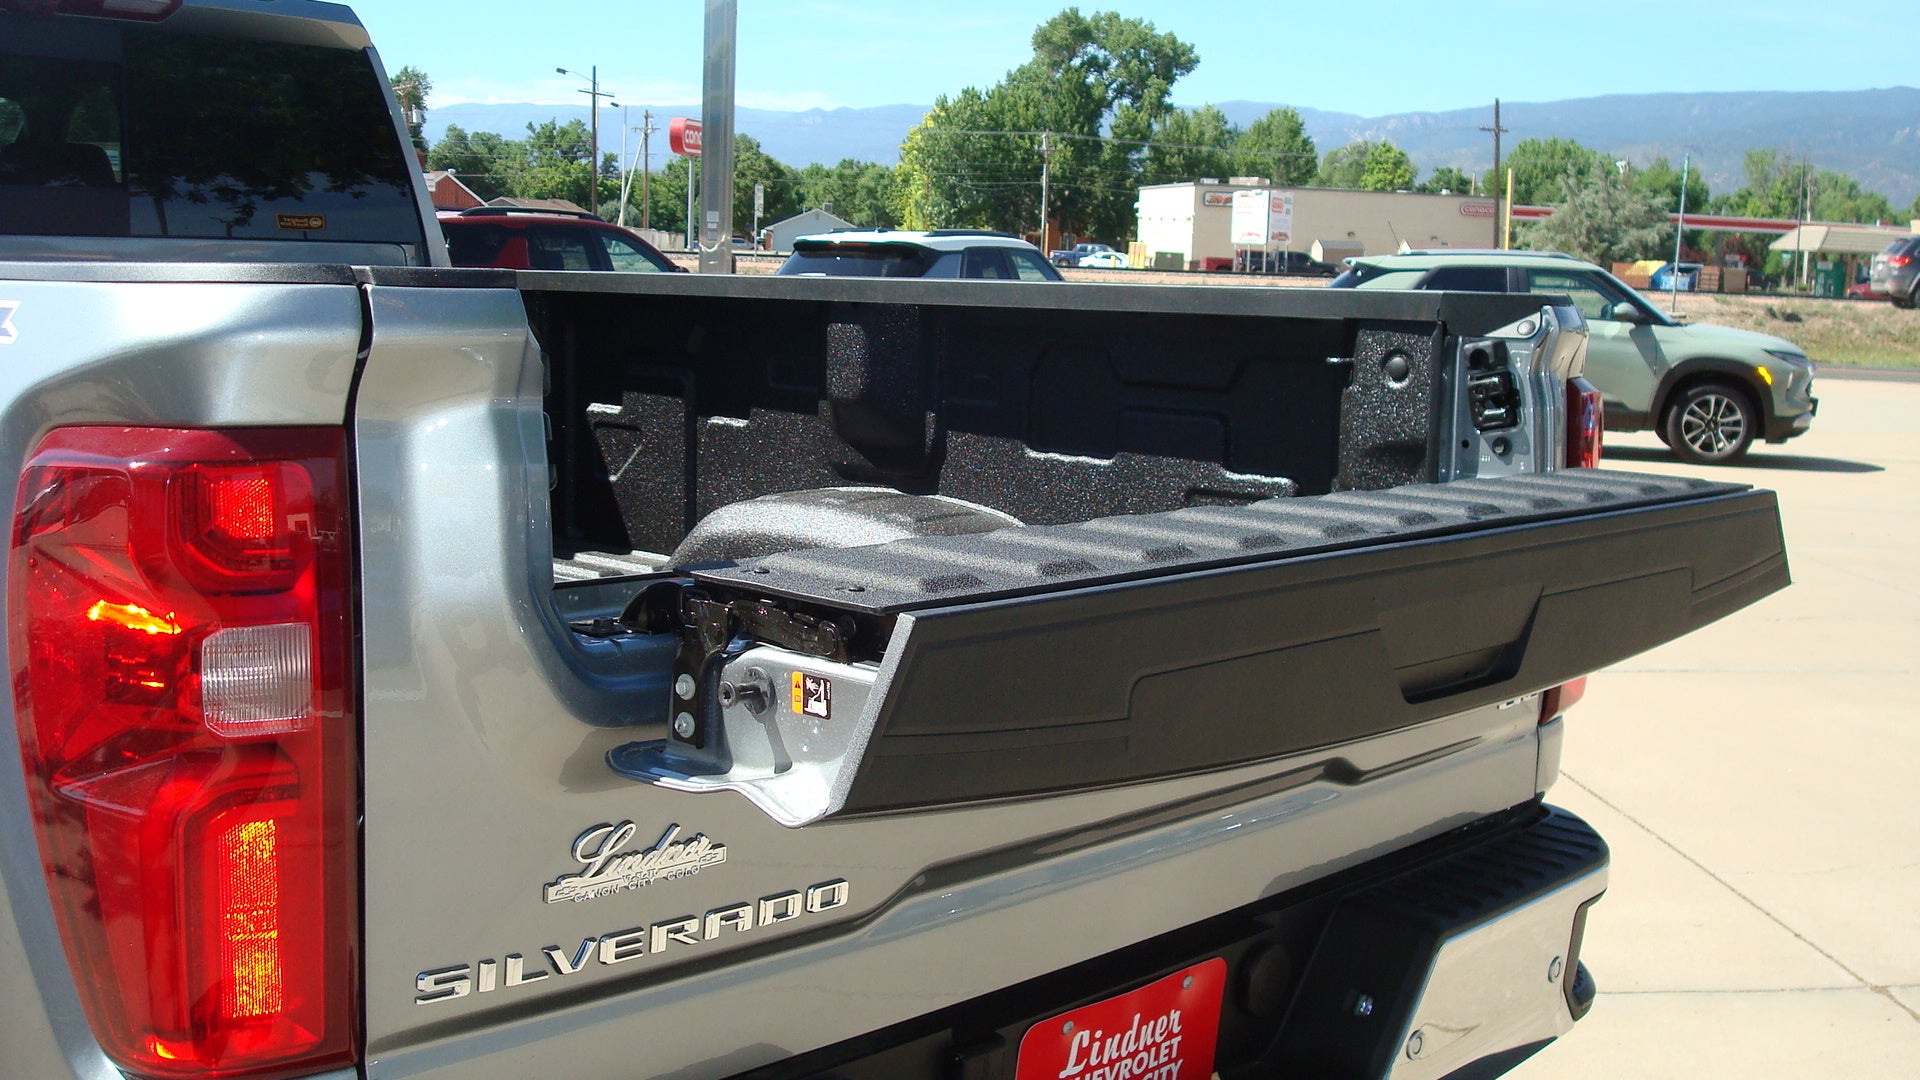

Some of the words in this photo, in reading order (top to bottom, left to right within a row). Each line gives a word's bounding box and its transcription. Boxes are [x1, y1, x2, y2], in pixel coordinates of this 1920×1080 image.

[684, 129, 702, 145] con
[415, 877, 849, 1005] SILVERADO
[1058, 1008, 1182, 1079] Lindner
[1069, 1035, 1182, 1080] EVROLET
